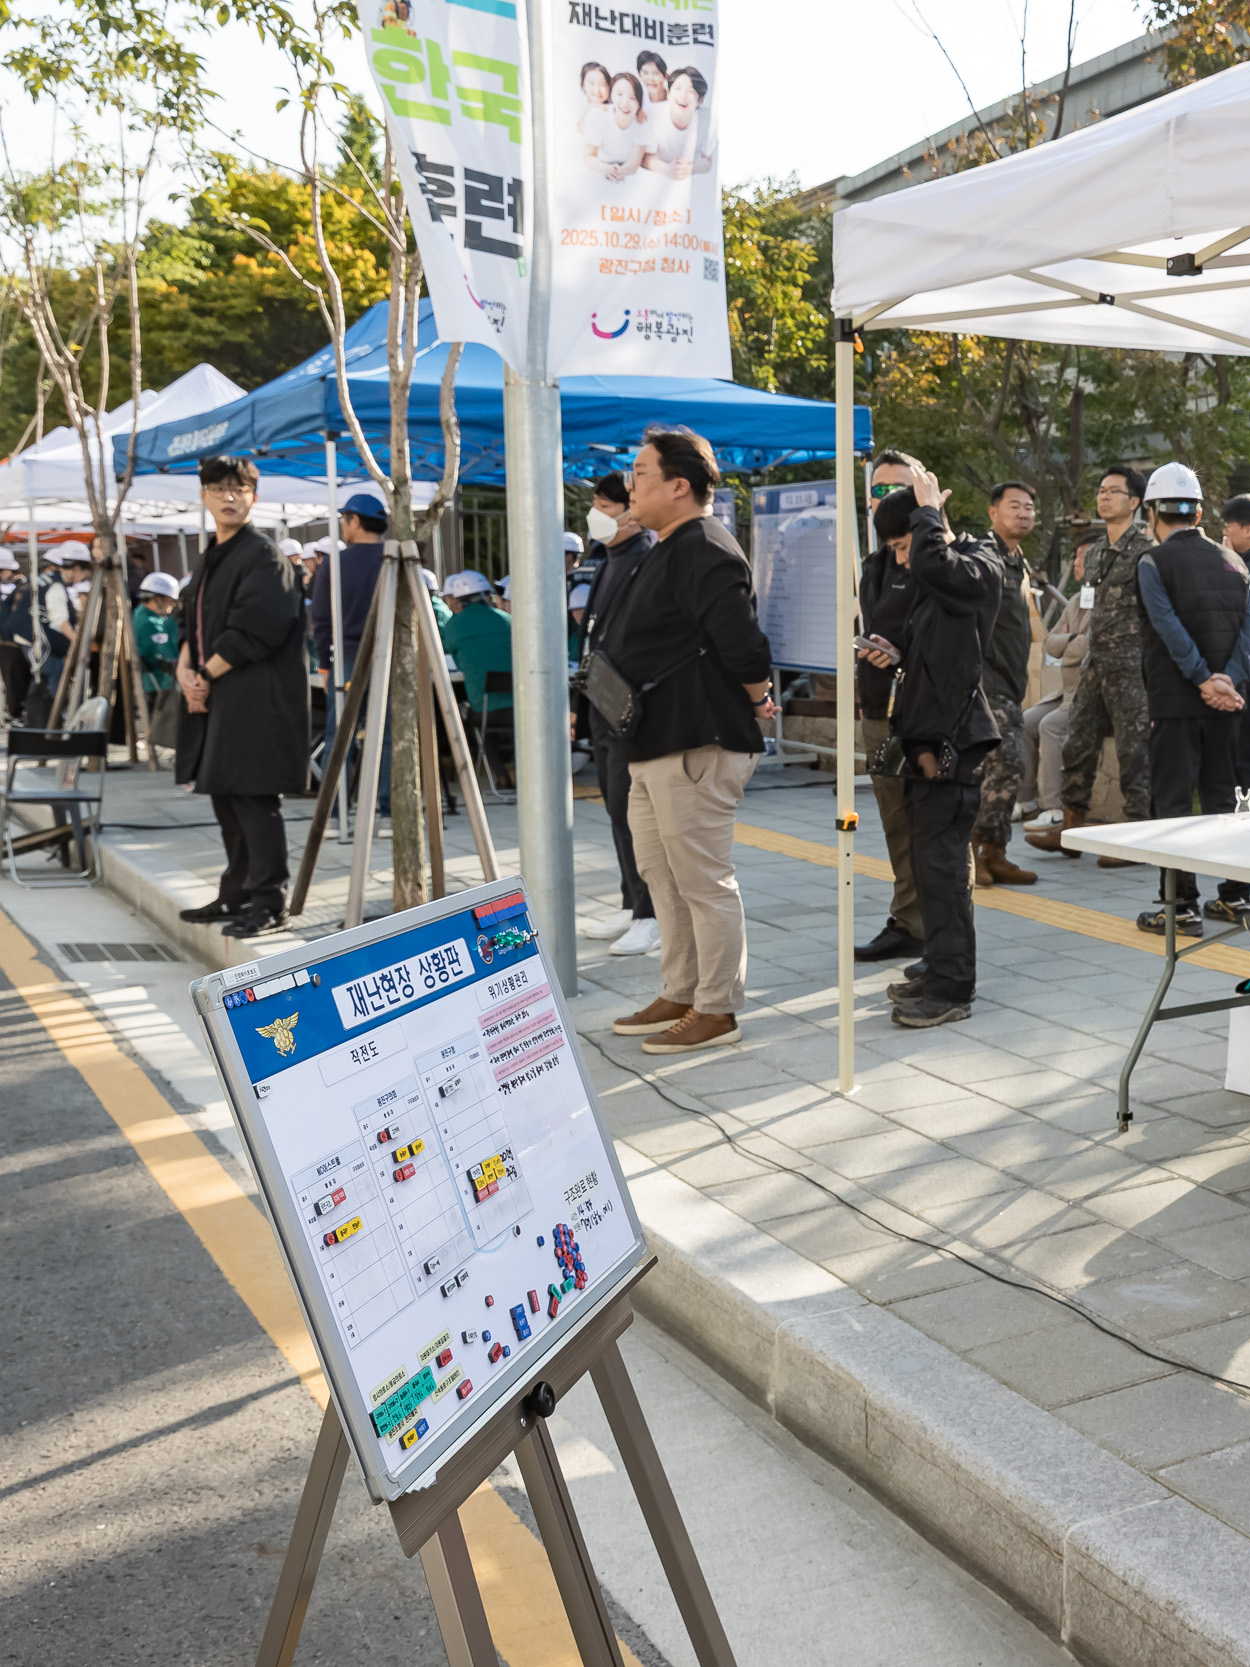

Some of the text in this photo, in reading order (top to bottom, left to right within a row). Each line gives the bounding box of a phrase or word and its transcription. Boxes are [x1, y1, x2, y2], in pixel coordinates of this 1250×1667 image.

[568, 1, 714, 47] 재난대비훈련
[599, 257, 690, 275] 광진구청 청사
[636, 321, 693, 343] 행복광진
[345, 944, 463, 1020] 재난현장 상황판
[487, 970, 529, 1000] 위기상황관리
[350, 1038, 380, 1065] 작전도
[562, 1169, 599, 1207] 구조완료 현황
